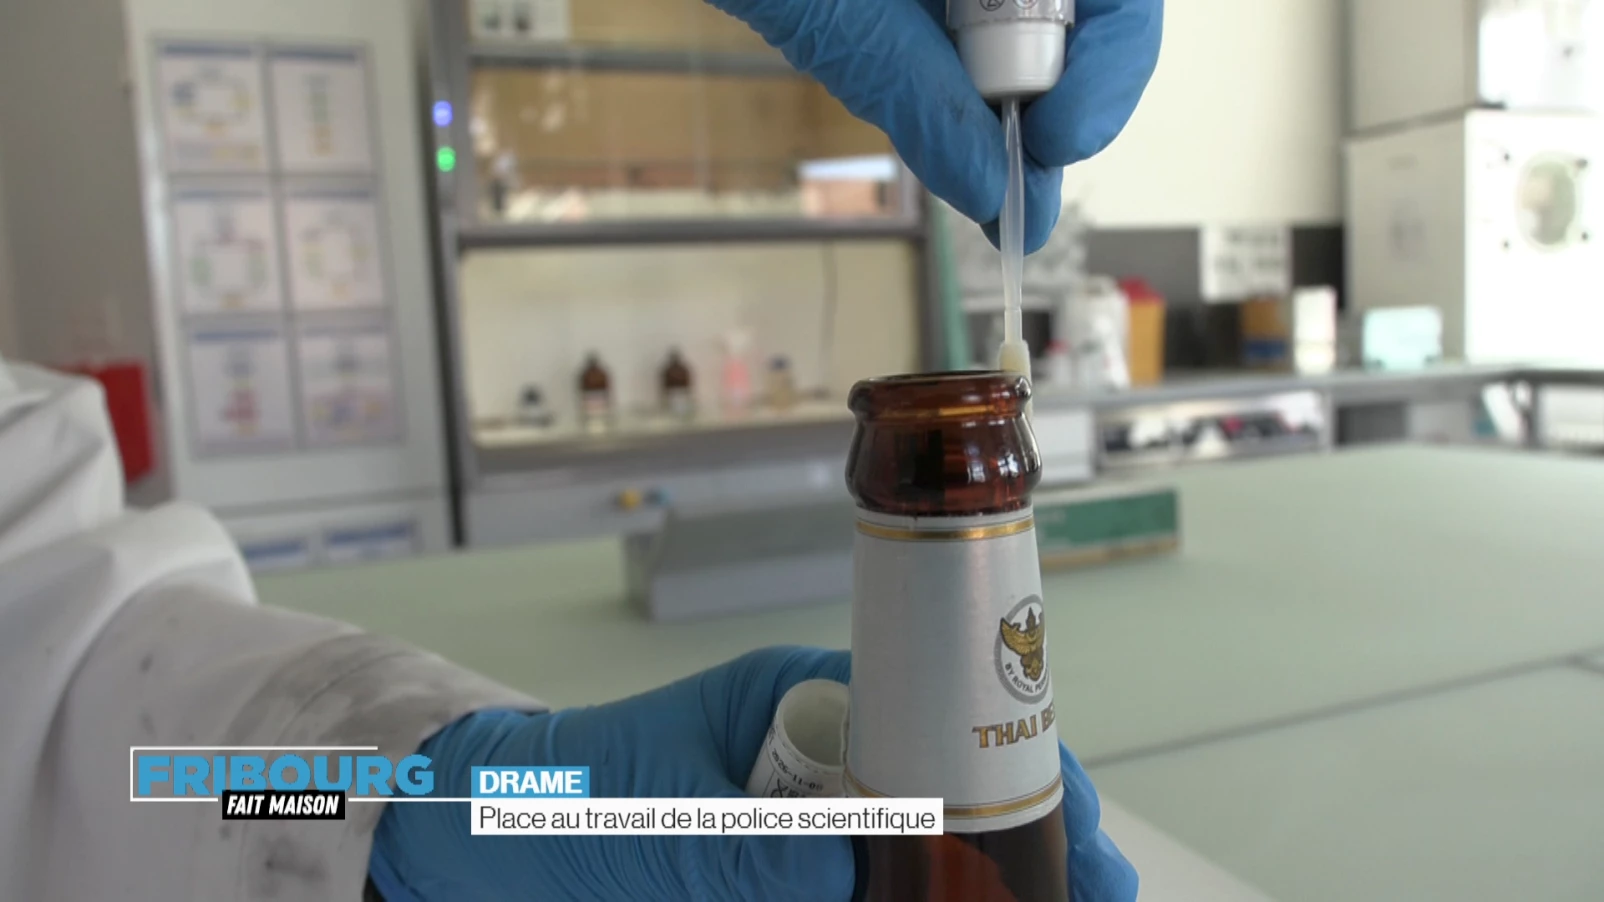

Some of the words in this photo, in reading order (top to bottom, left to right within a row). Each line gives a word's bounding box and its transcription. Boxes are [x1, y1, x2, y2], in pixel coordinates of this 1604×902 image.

[1005, 662, 1015, 676] BY
[1012, 675, 1034, 693] ROYAL
[972, 714, 1038, 748] THAI
[1041, 700, 1056, 733] BE
